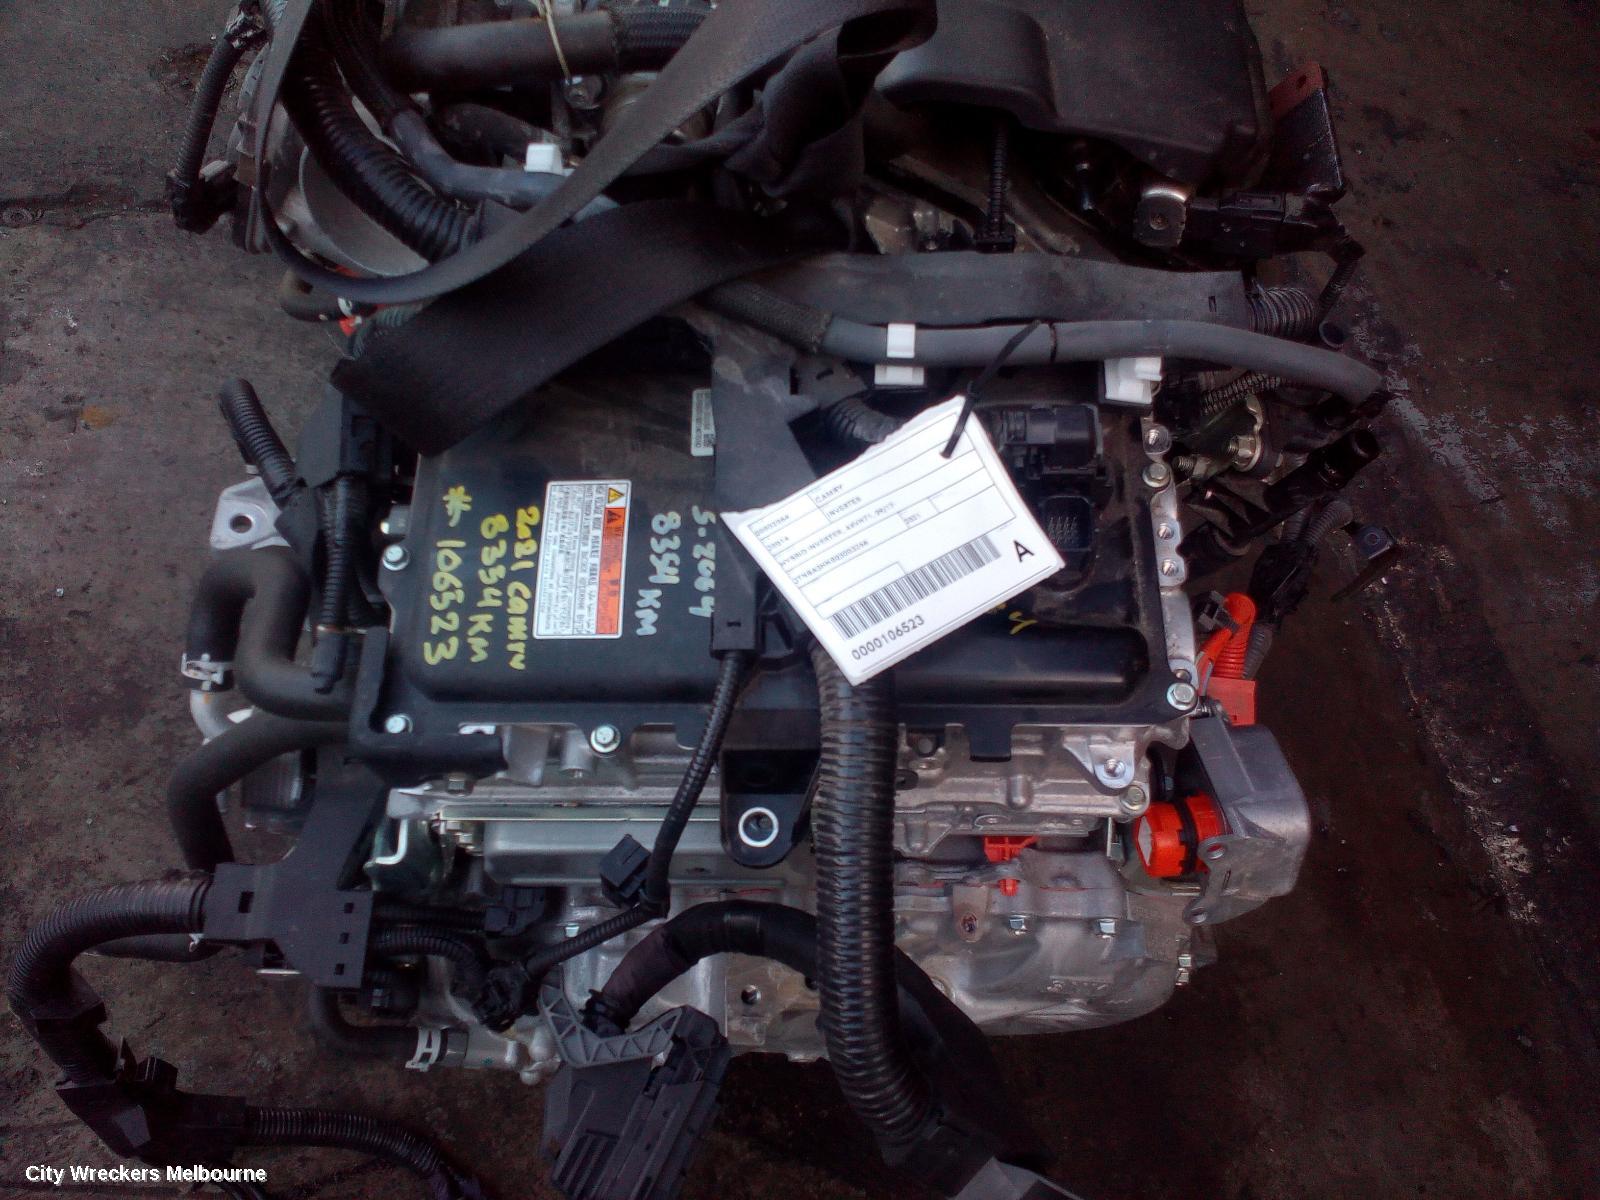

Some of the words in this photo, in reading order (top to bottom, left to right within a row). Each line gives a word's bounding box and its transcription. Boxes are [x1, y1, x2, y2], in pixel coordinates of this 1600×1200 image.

[1013, 540, 1035, 562] A
[423, 540, 466, 665] 106523
[851, 615, 925, 661] 0000106523
